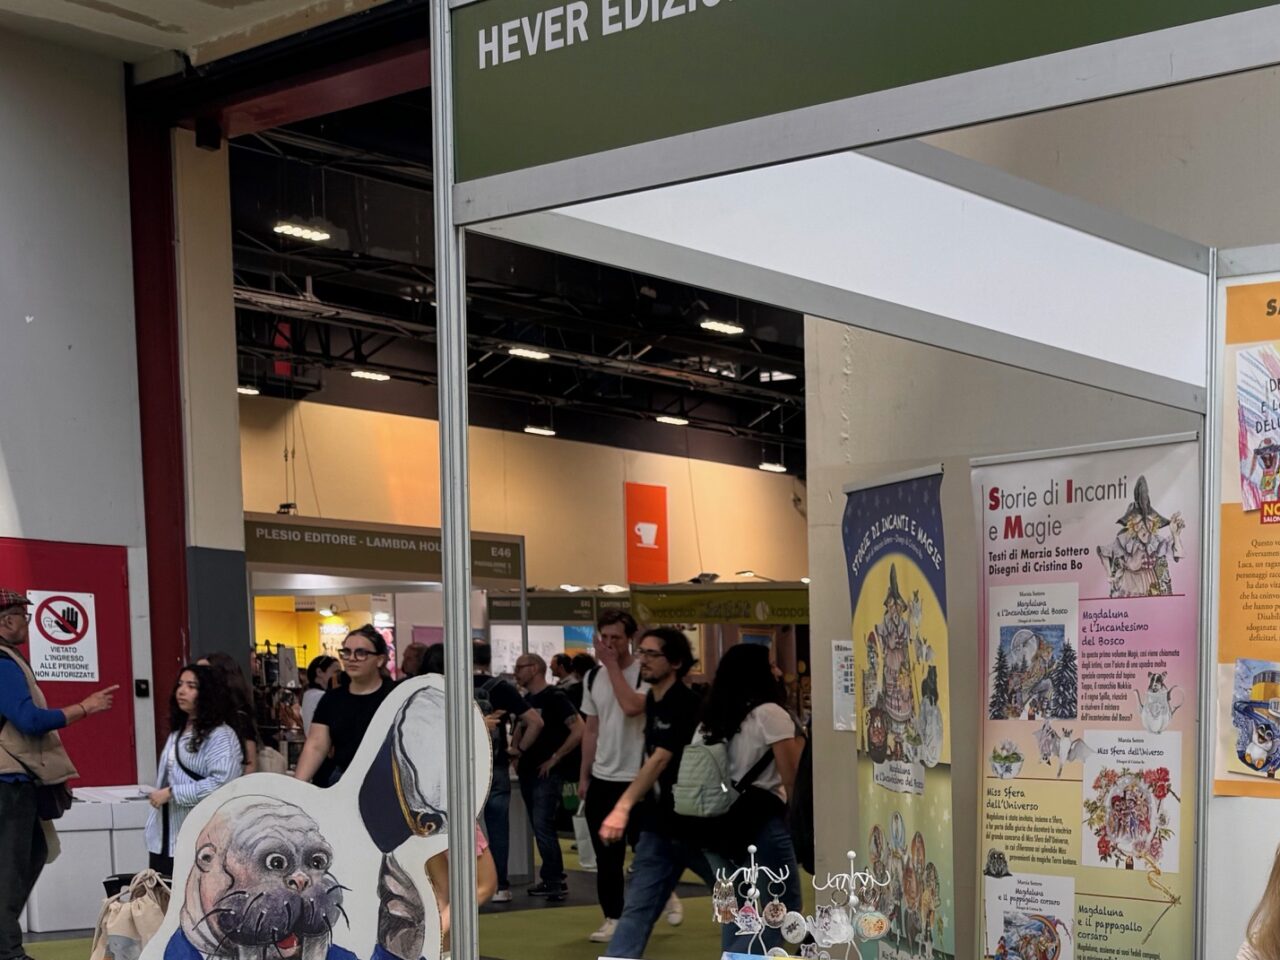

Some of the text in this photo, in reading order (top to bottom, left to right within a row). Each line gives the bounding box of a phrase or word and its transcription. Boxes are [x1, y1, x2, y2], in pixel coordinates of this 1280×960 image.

[478, 0, 588, 70] HEVER
[1260, 400, 1268, 413] E
[988, 475, 1128, 511] Storie di Incanti
[988, 513, 1063, 544] e Magie
[255, 528, 443, 553] PLESIO EDITORE LAMBDA HOU
[490, 546, 512, 559] E46
[988, 545, 1090, 562] Testi di Marzia Sottero
[988, 559, 1083, 576] Disegni di Cristina Bo
[44, 654, 84, 662] L'INGRESSO
[40, 662, 57, 670] ALLE
[50, 671, 95, 679] AUTORIZZATE
[987, 785, 1025, 799] Miss Sfera
[986, 799, 1039, 811] dell'Universo
